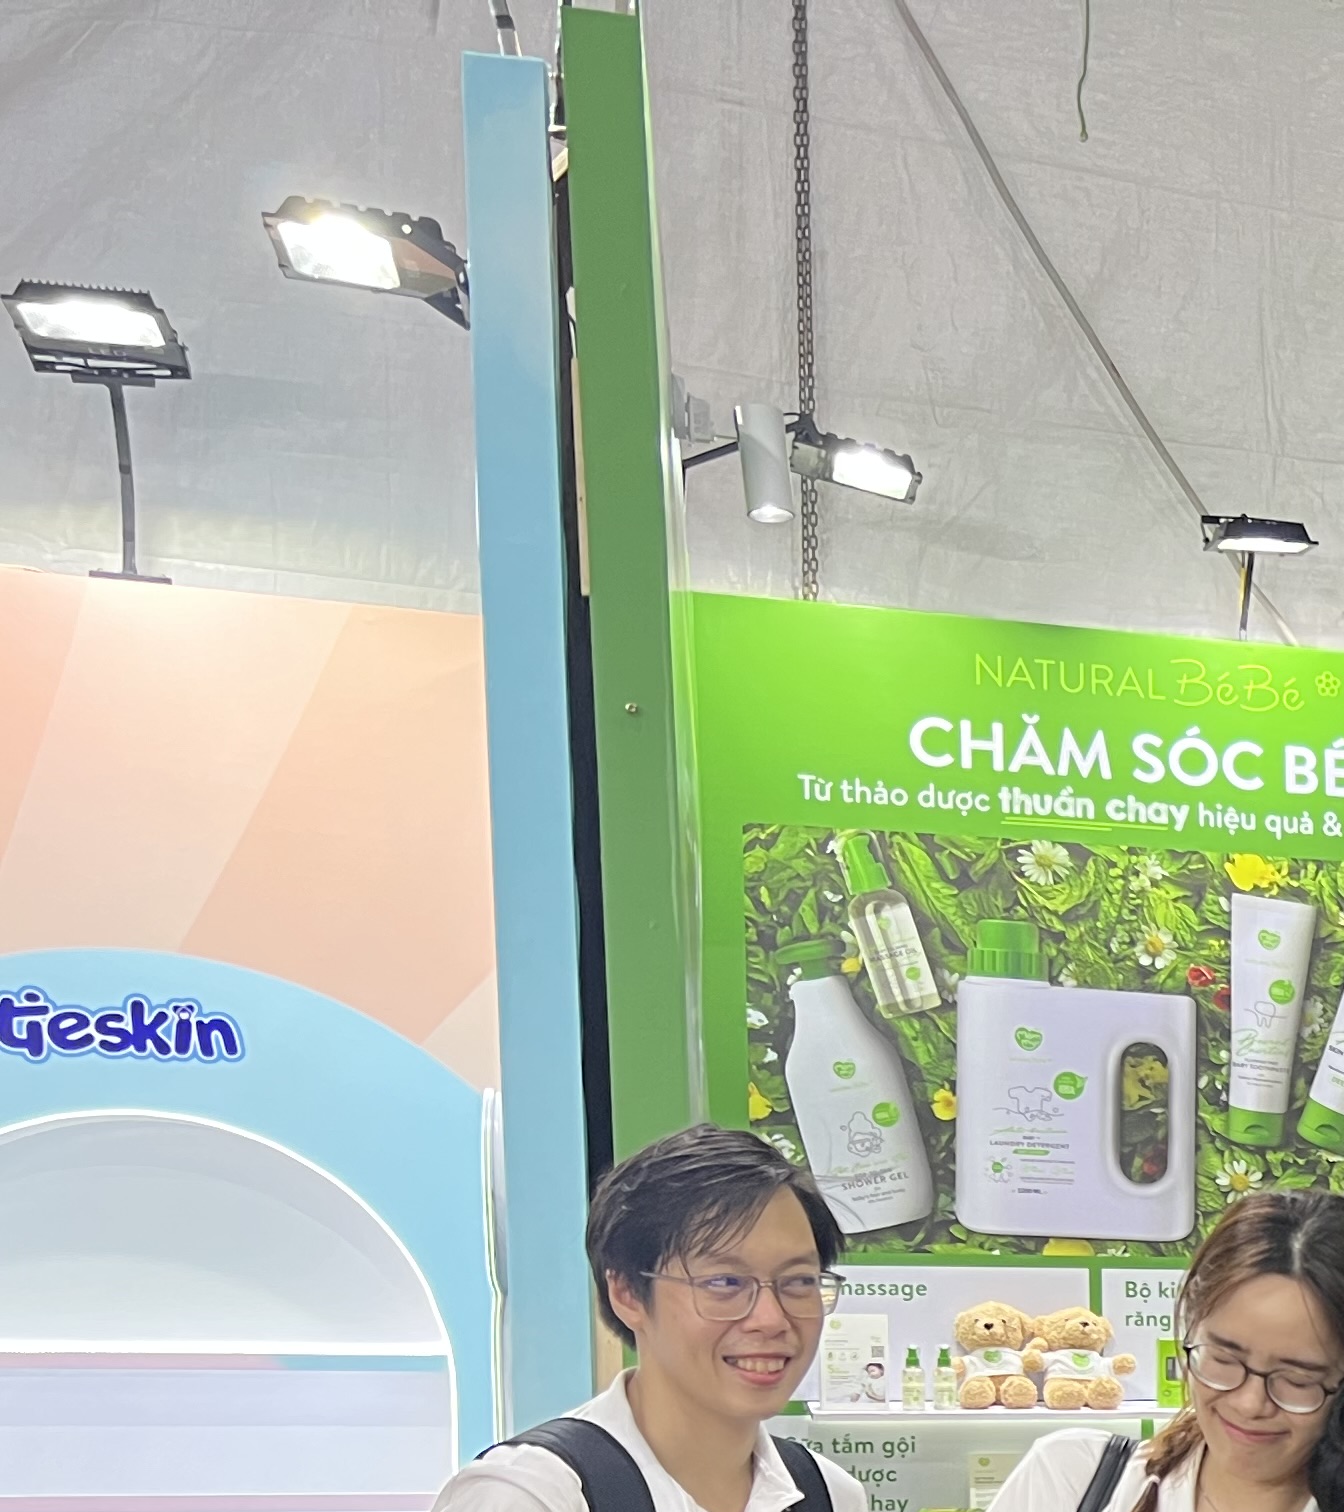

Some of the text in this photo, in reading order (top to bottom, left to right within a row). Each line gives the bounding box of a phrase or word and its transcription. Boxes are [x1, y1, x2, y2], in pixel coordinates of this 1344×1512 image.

[975, 653, 1305, 712] NATURAL BéBé
[909, 713, 1112, 780] CHĂM
[1131, 725, 1265, 791] SÓC
[797, 773, 832, 801] Từ
[841, 777, 908, 806] thảo
[918, 783, 990, 816] dược
[1000, 786, 1095, 819] thuần
[1106, 795, 1190, 831] chay
[1198, 802, 1256, 835] hiệu
[1265, 811, 1314, 840] quả
[1323, 811, 1343, 838] &
[1125, 1281, 1151, 1303] Bộ
[1125, 1311, 1171, 1332] răng
[832, 1433, 874, 1453] tắm
[882, 1435, 916, 1458] gội
